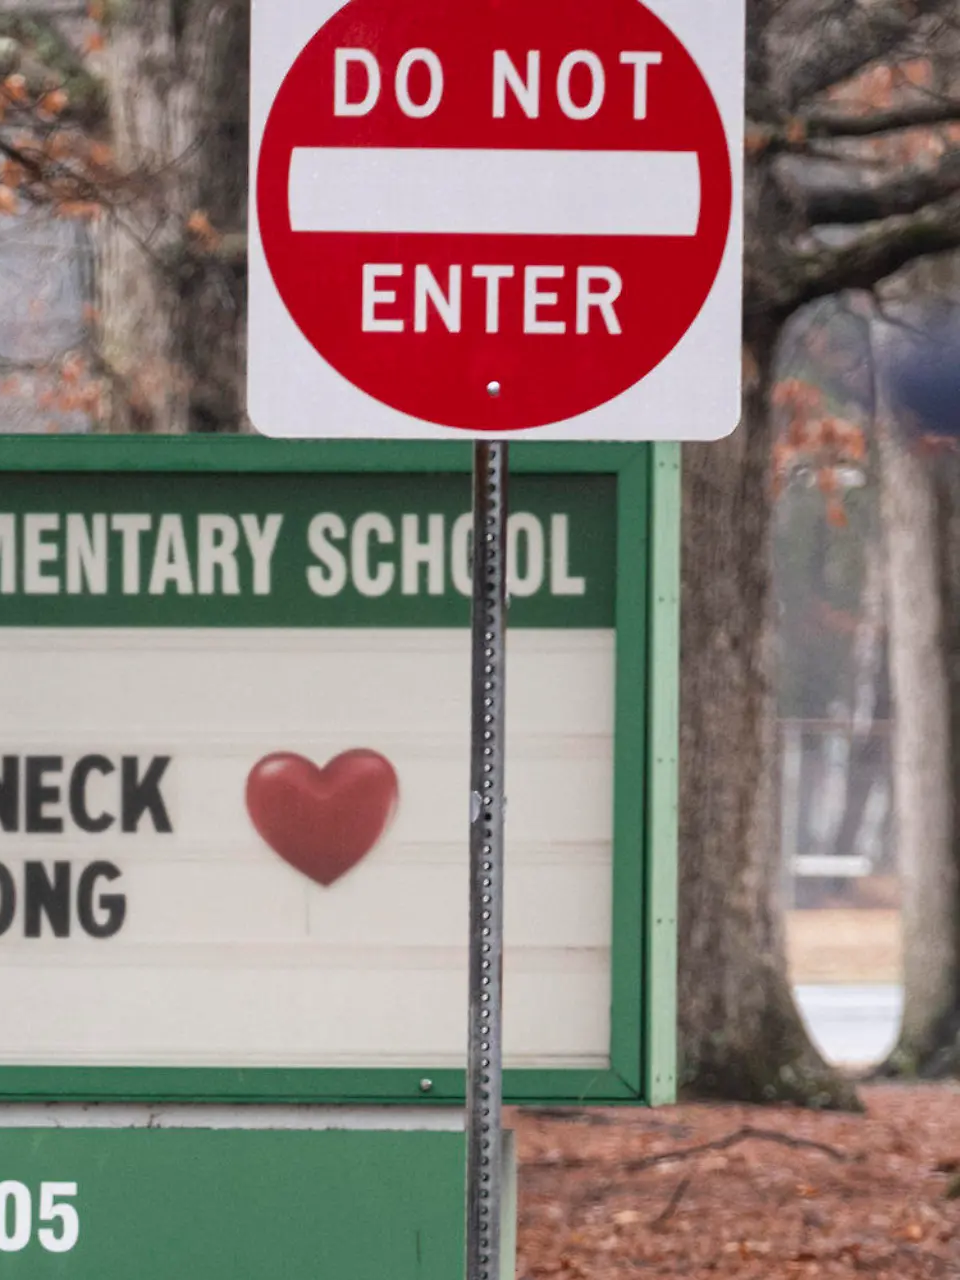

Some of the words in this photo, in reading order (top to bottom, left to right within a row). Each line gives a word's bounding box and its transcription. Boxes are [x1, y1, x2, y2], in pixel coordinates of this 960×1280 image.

[333, 47, 444, 118] DO
[492, 49, 663, 120] NOT
[361, 263, 623, 335] ENTER
